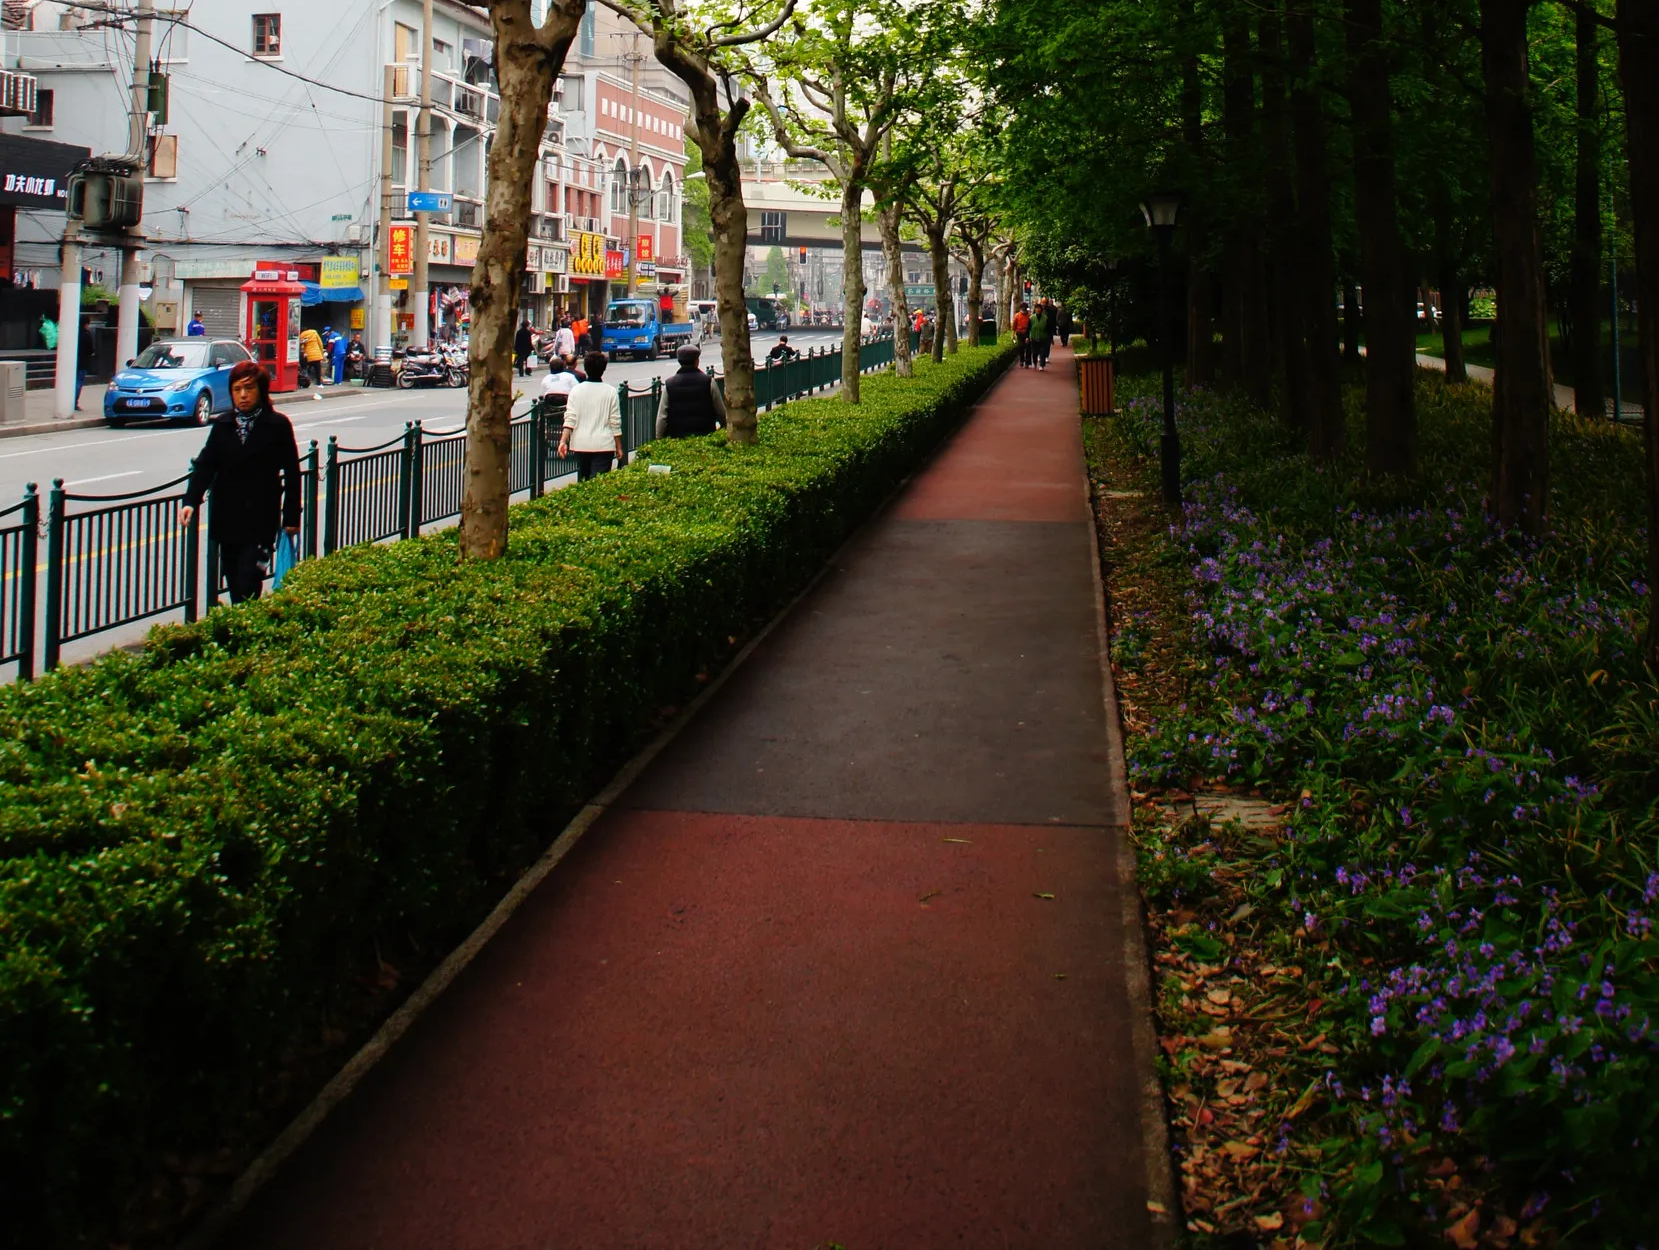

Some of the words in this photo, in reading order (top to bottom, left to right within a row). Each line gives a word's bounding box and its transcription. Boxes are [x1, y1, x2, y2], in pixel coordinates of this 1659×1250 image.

[4, 174, 55, 195] 功夫小龙虾
[392, 229, 407, 257] 修车
